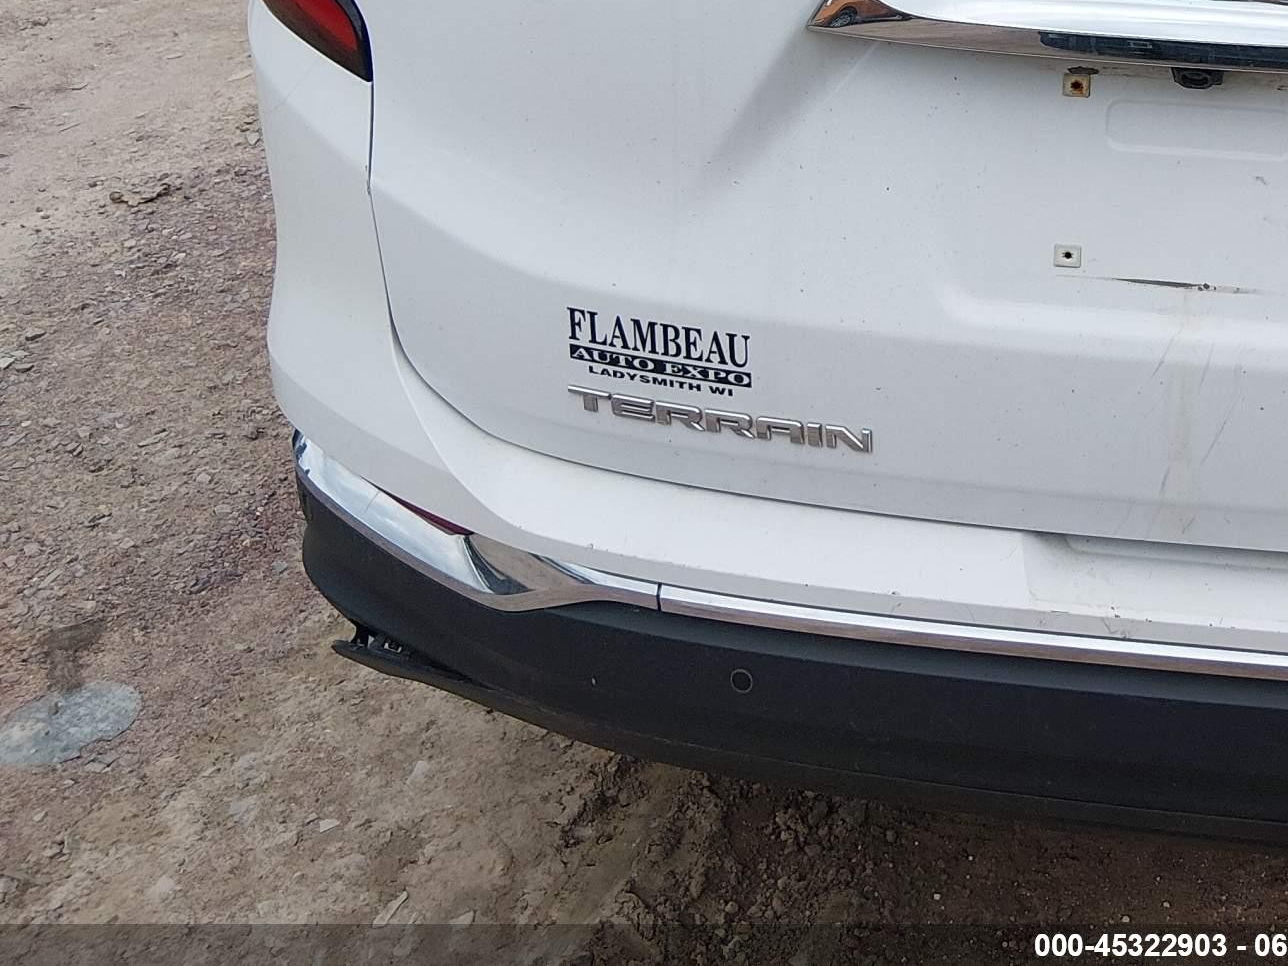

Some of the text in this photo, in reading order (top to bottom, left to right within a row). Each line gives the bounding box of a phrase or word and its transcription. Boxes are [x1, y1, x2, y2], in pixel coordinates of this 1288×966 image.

[566, 307, 751, 368] FLAMBEAU
[571, 347, 751, 385] AUTO EXPO
[588, 365, 734, 397] LADYSMITH WI
[567, 384, 873, 454] TERRAIN
